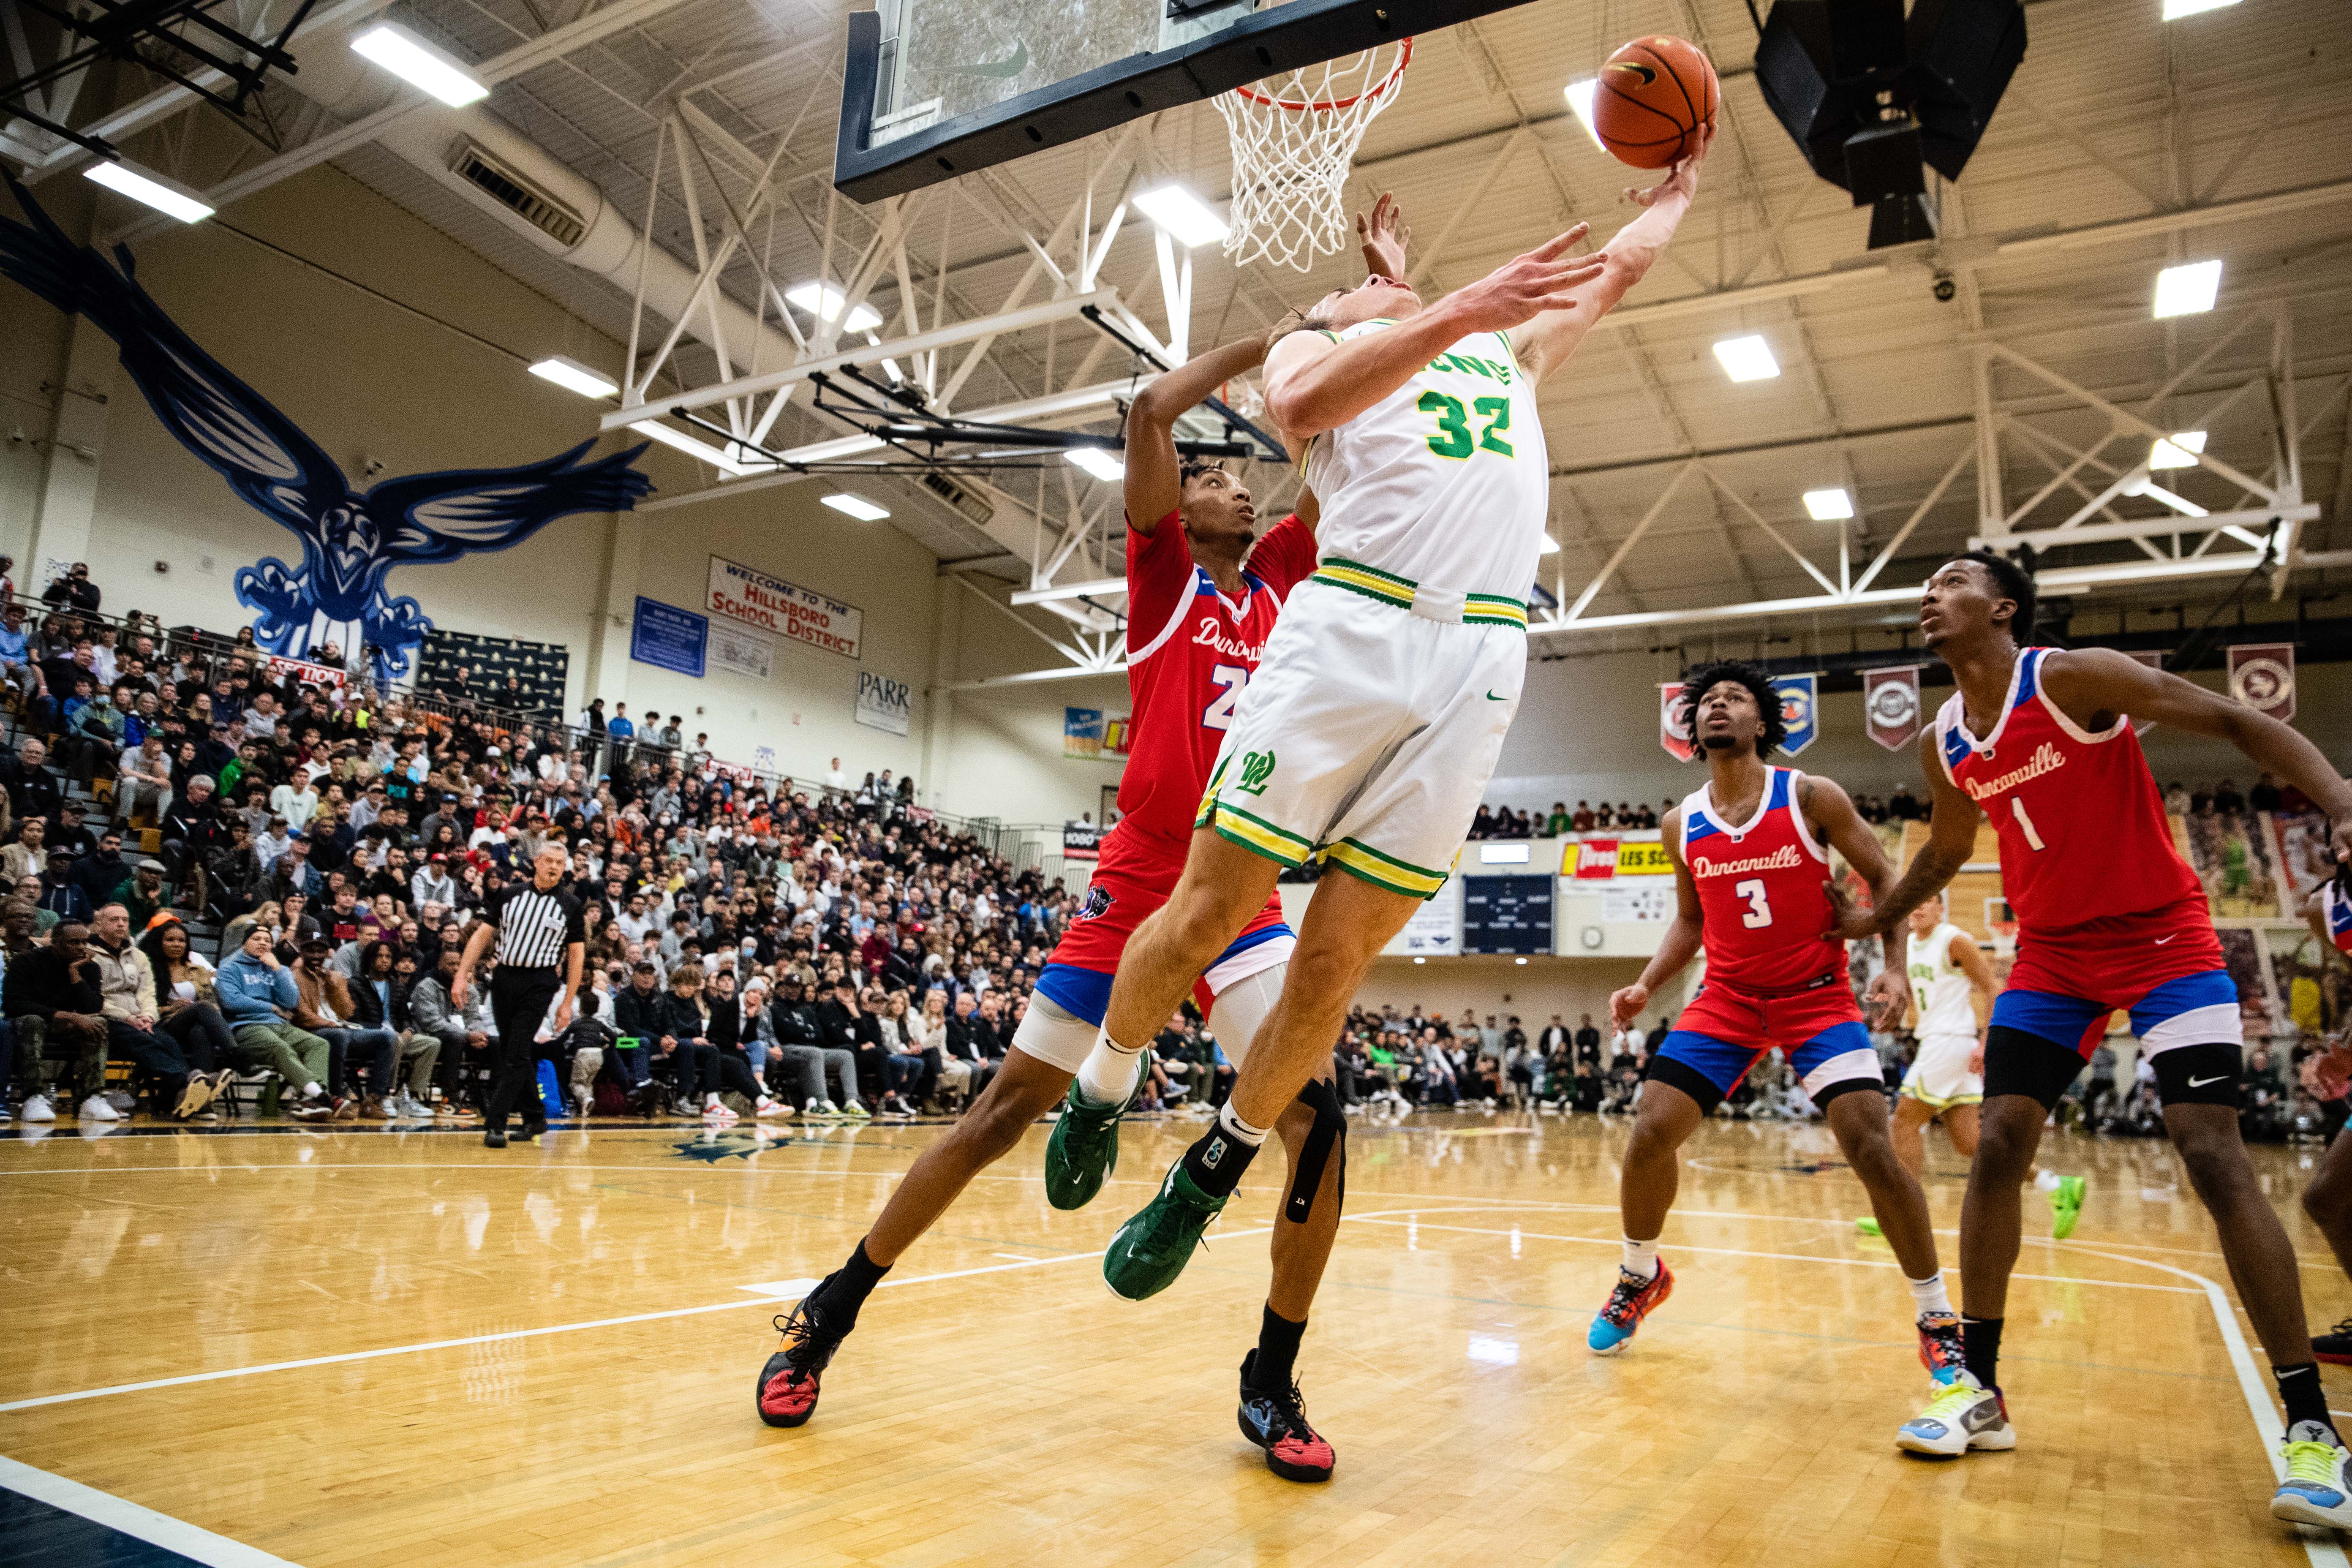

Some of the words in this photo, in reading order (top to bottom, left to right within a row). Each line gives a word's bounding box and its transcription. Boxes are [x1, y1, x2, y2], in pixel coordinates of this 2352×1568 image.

[1416, 390, 1514, 461] 32
[726, 564, 794, 597] WELCOME
[803, 592, 818, 605] TO
[825, 601, 848, 616] THE
[745, 584, 830, 628] HILLSBORO
[713, 591, 777, 629] SCHOOL
[788, 617, 855, 653] DISTRICT
[860, 671, 909, 709] PARR
[1201, 662, 1250, 732] 2
[1965, 741, 2067, 801] Duncanville
[2011, 795, 2046, 852] 1
[1693, 844, 1802, 879] Duncanville
[1735, 878, 1773, 930] 3
